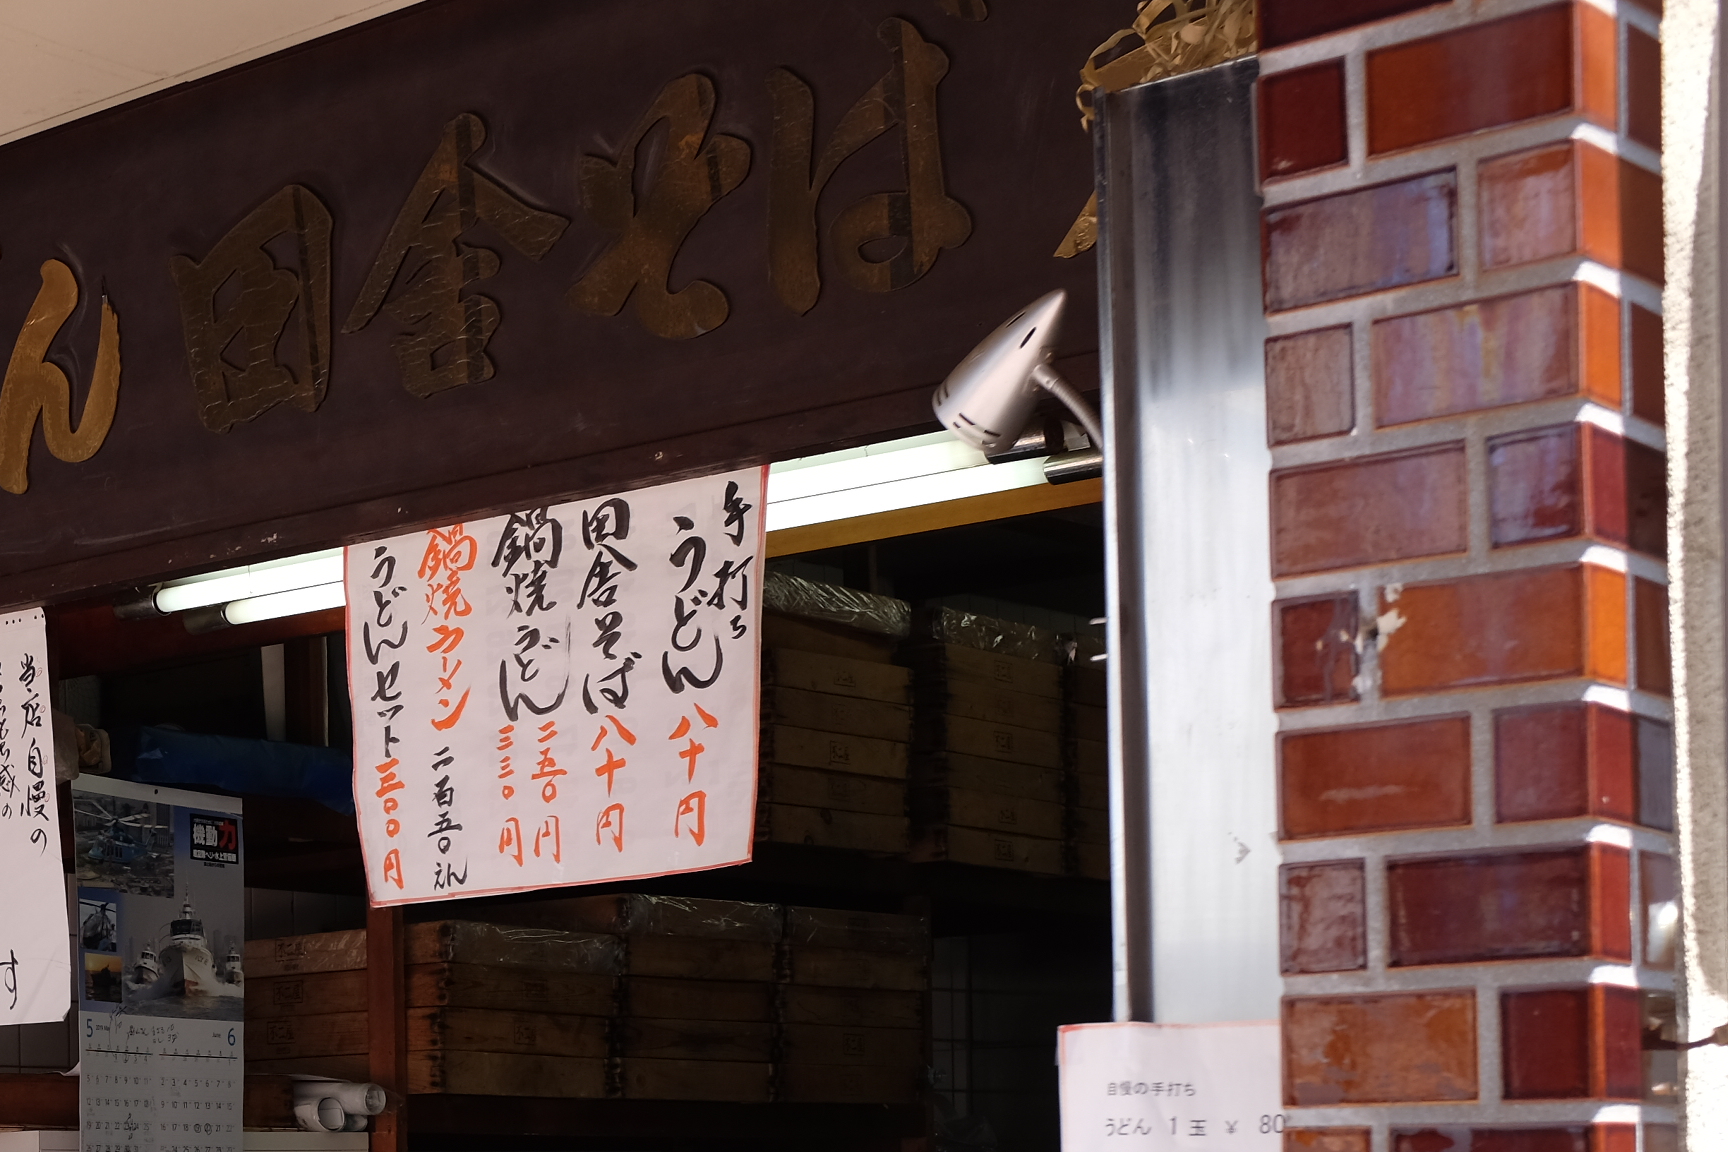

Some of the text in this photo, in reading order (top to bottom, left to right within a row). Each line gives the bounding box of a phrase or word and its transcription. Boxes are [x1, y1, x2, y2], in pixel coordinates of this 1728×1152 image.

[491, 506, 571, 722] 鍋焼うどん
[708, 481, 753, 640] 手打ち
[363, 546, 408, 759] うどんセット
[577, 498, 642, 853] 田舎そば 八十円
[662, 515, 723, 847] うどん 八十円
[19, 654, 49, 857] 当店自慢の
[86, 1018, 94, 1037] 5
[227, 1028, 236, 1046] 6
[1107, 1081, 1197, 1097] 自慢の手打ち
[1105, 1117, 1152, 1136] うどん
[1169, 1116, 1177, 1135] 1
[1188, 1119, 1207, 1136] 玉
